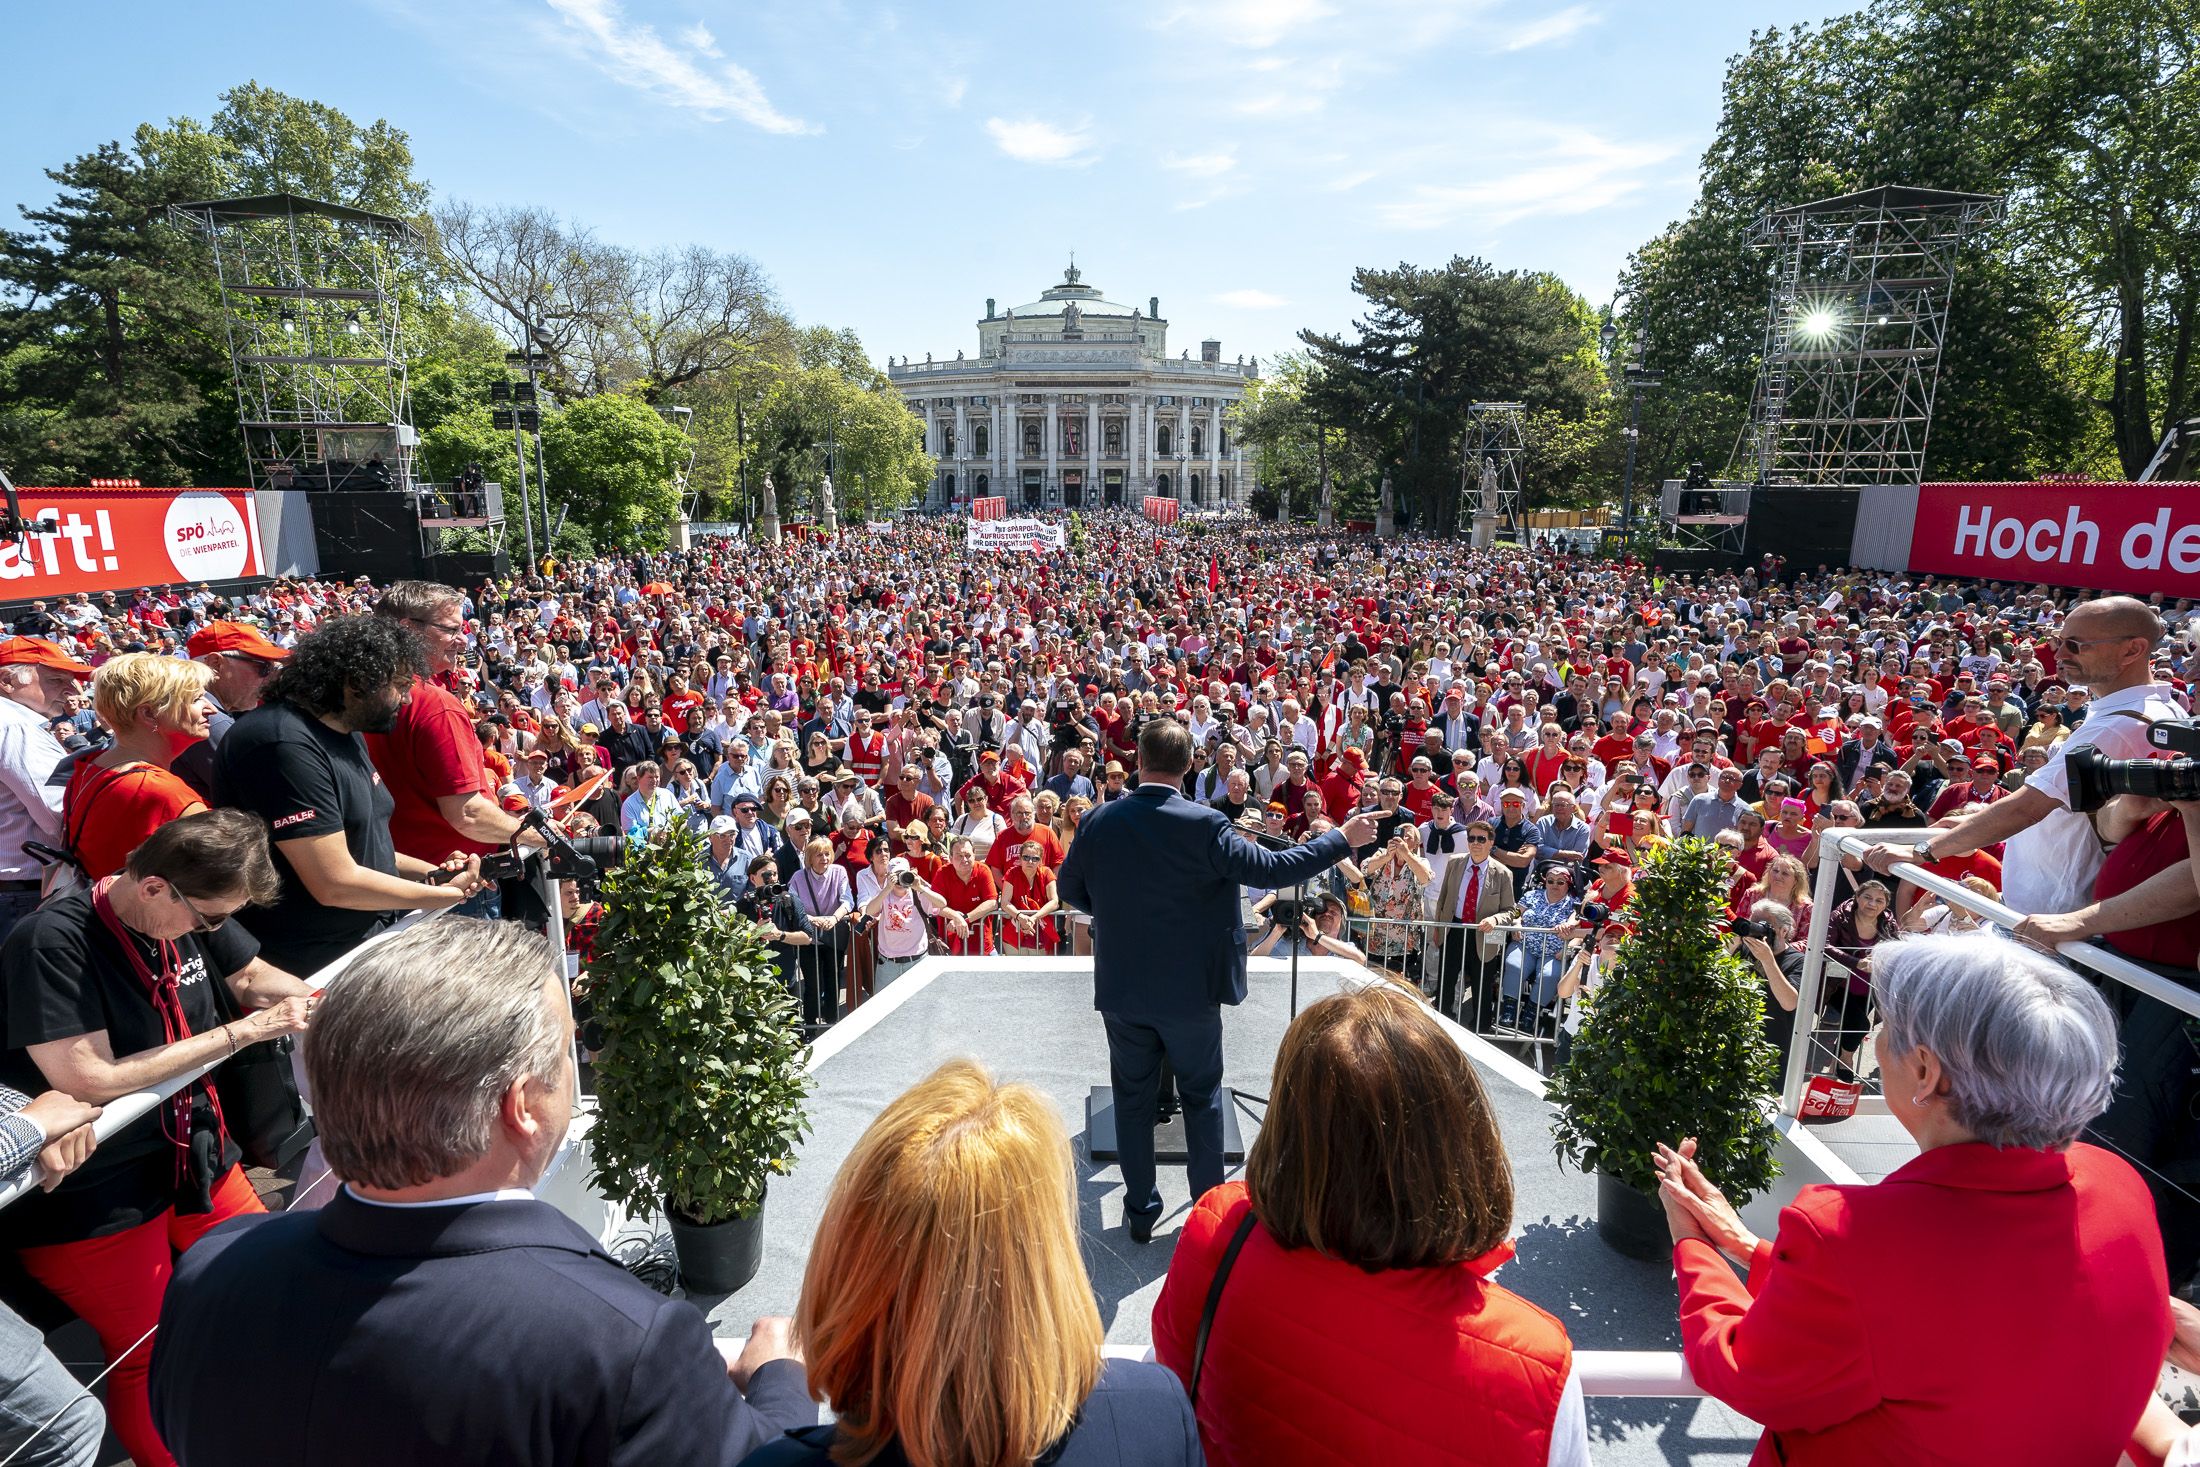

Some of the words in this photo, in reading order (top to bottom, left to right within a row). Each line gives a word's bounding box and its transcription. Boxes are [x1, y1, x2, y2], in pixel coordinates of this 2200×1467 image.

[177, 522, 204, 542] SPÖ
[1953, 505, 2100, 565] Hoch
[179, 547, 192, 557] DIE
[274, 809, 315, 829] BABLER
[540, 825, 559, 845] RONIN
[1826, 1104, 1850, 1117] Wien
